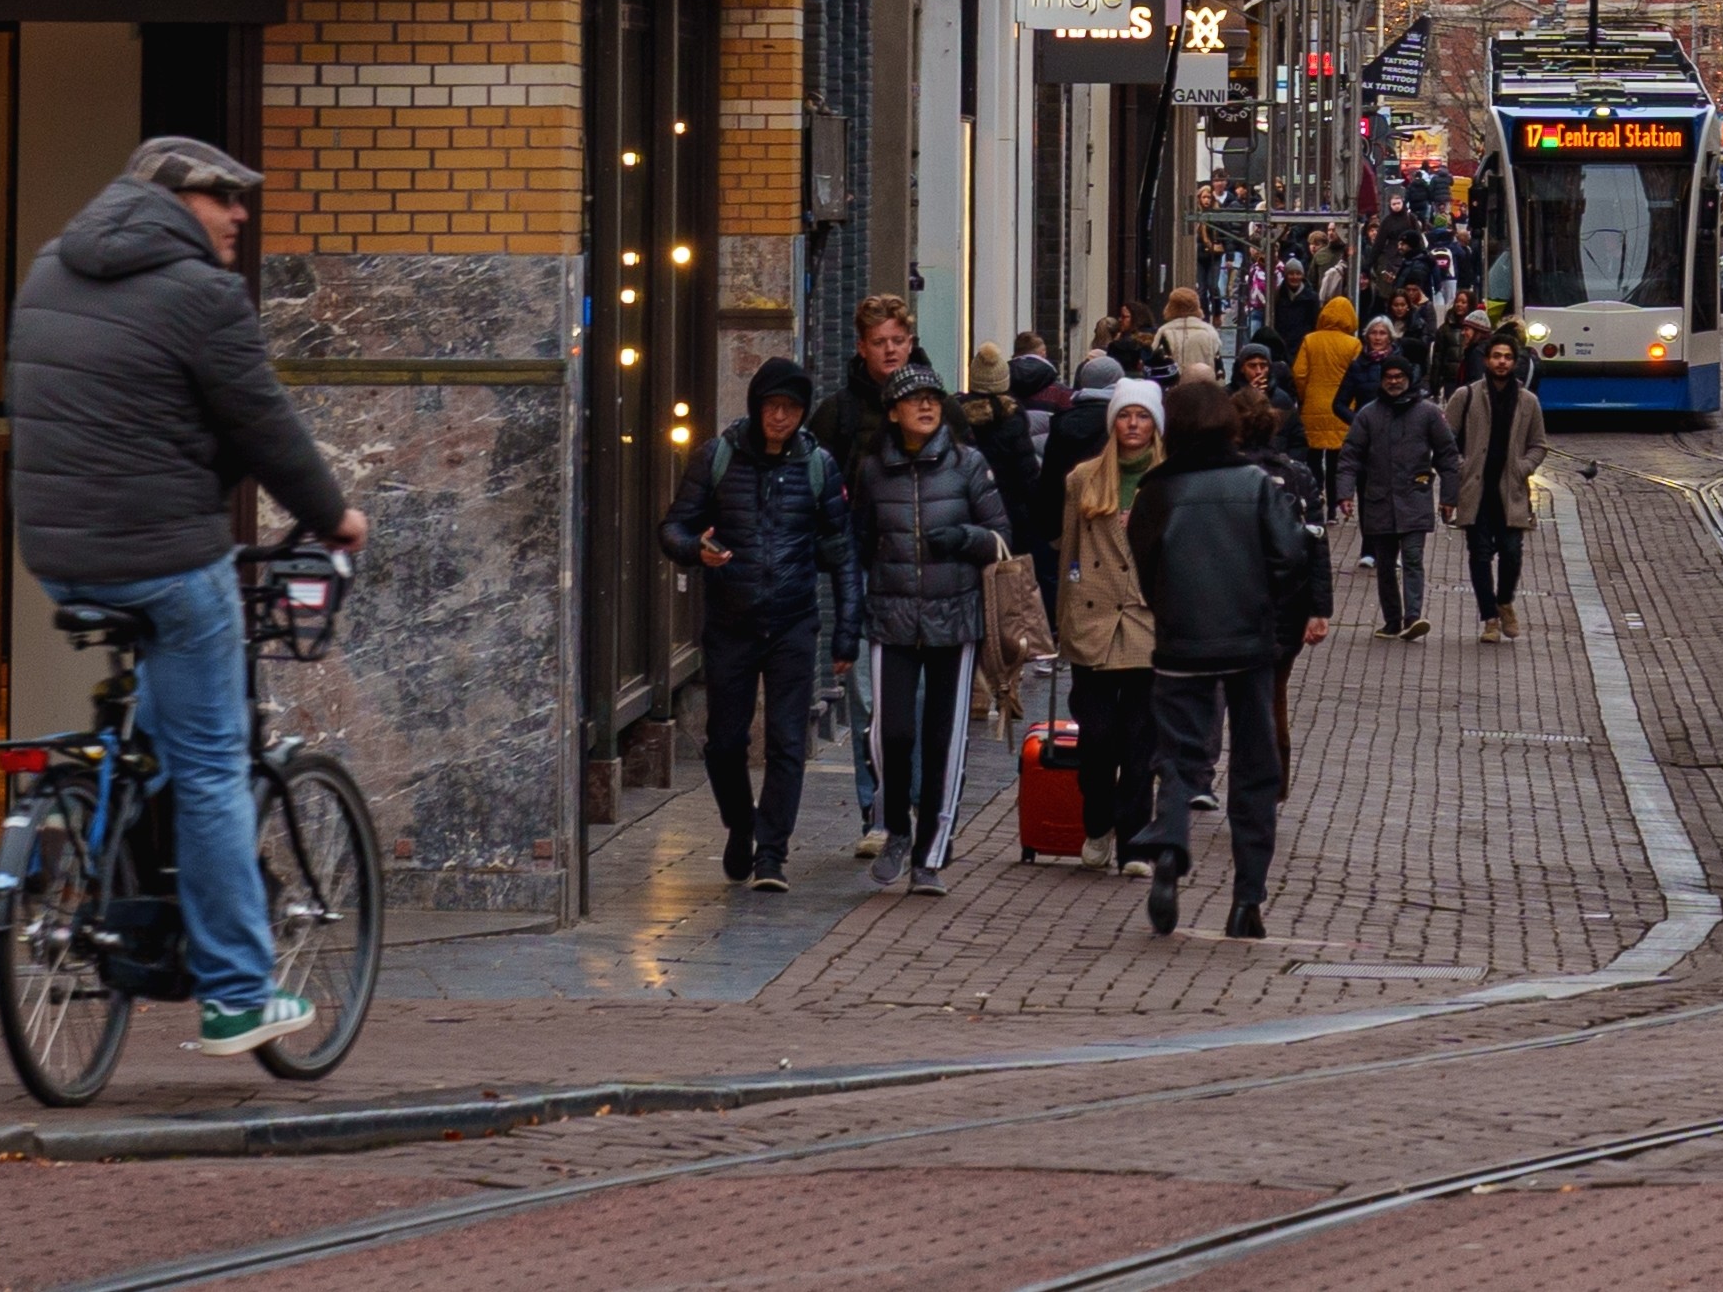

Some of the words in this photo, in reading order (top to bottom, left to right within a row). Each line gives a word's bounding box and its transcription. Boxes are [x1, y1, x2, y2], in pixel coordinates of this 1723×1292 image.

[1383, 56, 1419, 67] TATTOOS
[1381, 74, 1418, 84] TATTOOS
[1375, 82, 1416, 94] TATTOOS
[1173, 88, 1226, 103] GANNI
[1526, 124, 1542, 147] 17
[1557, 124, 1620, 147] Centraal
[1625, 124, 1682, 147] Station
